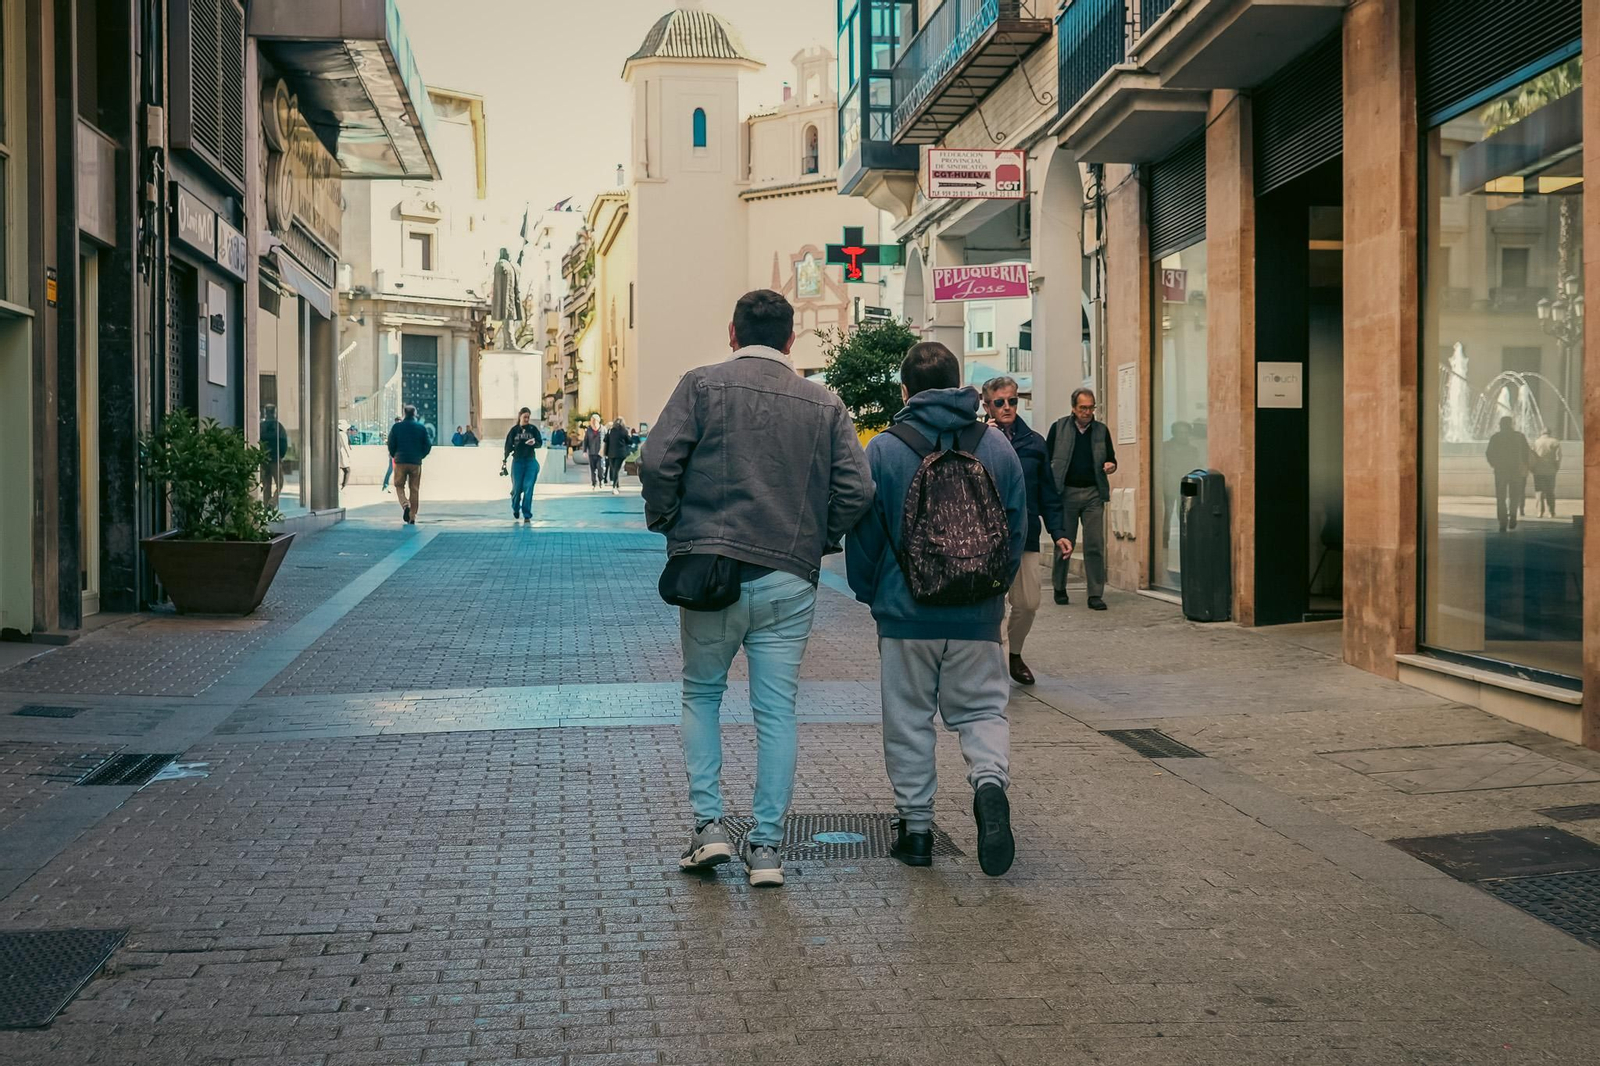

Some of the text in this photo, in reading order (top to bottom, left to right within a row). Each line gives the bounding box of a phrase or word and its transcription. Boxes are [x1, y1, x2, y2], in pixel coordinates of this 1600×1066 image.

[996, 181, 1020, 190] CGT
[934, 266, 1025, 288] PELUQUERIA
[952, 279, 1007, 300] Jose
